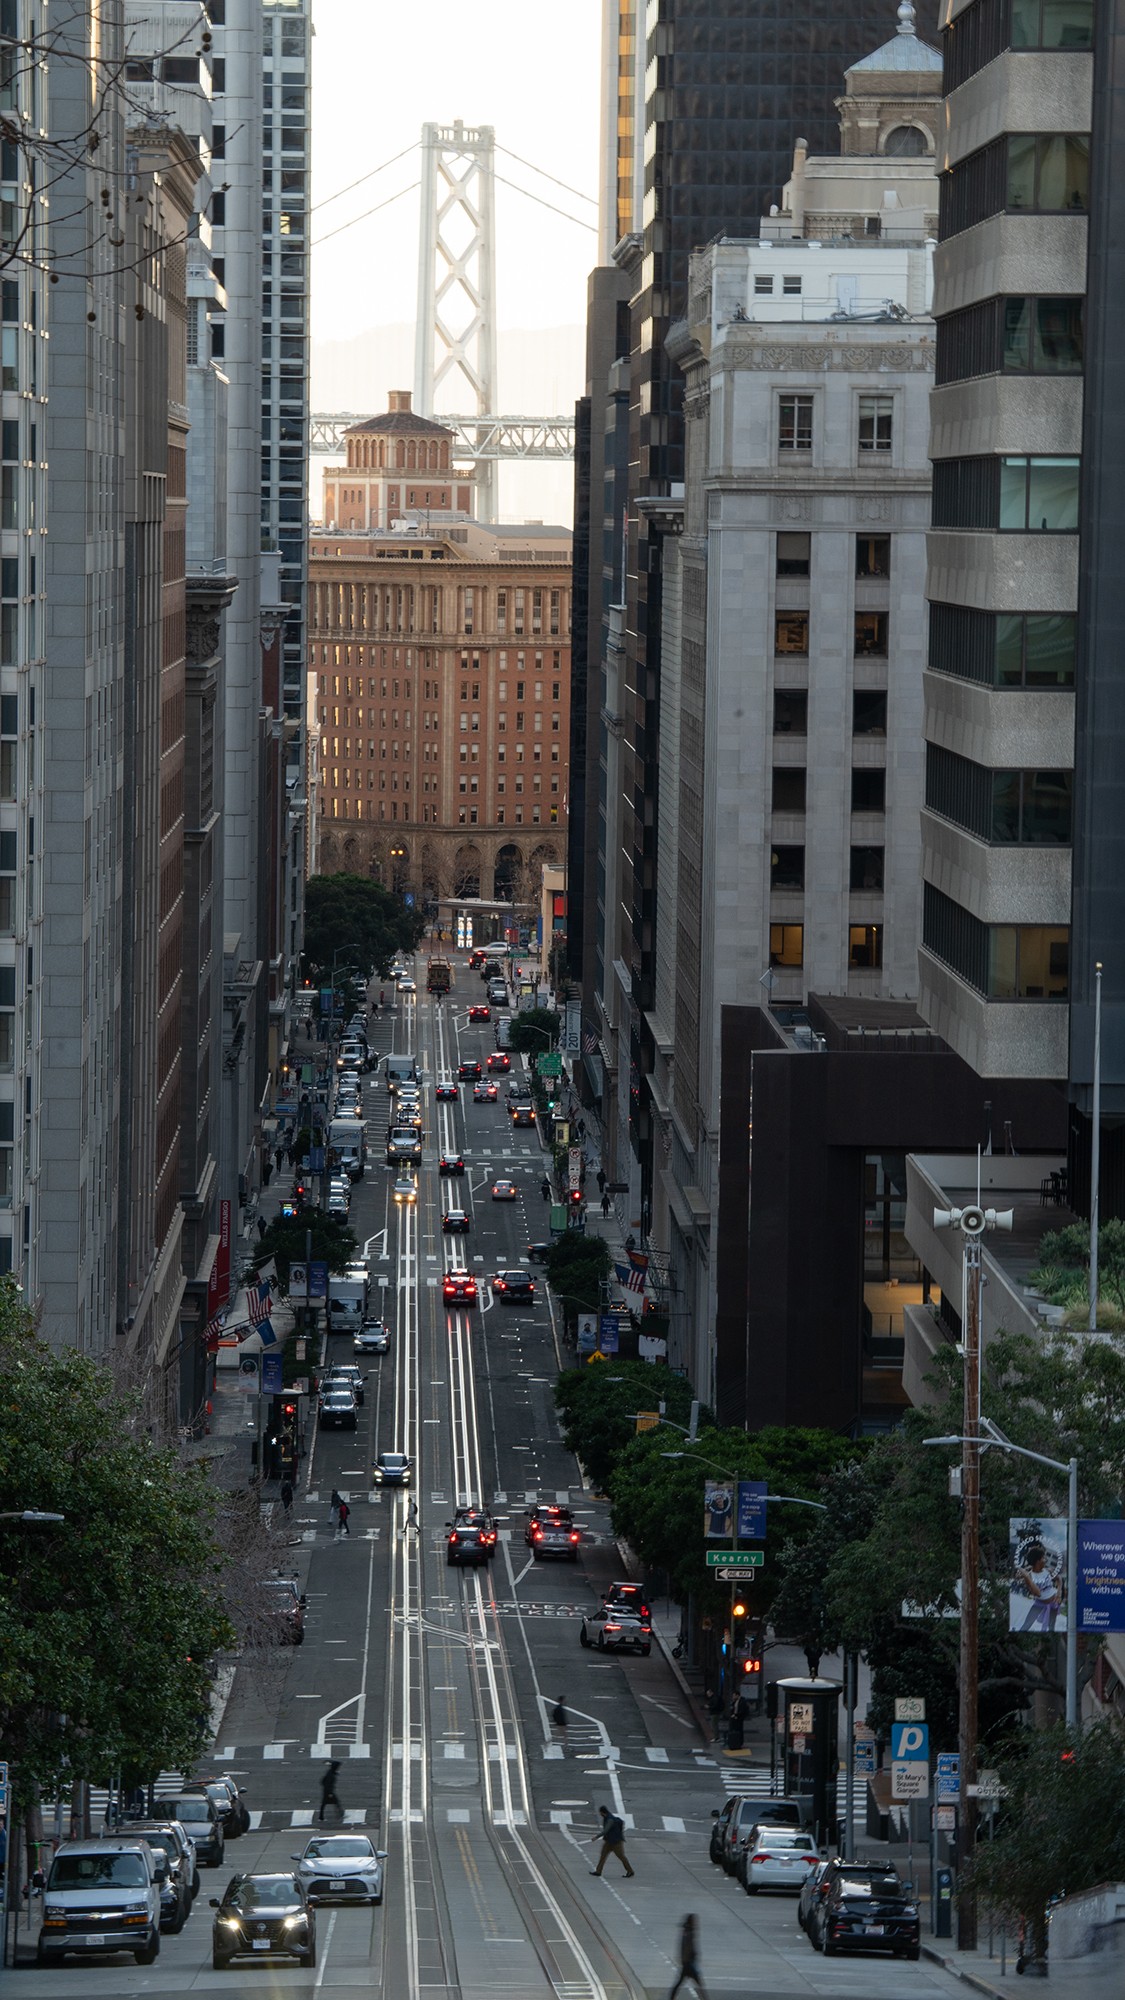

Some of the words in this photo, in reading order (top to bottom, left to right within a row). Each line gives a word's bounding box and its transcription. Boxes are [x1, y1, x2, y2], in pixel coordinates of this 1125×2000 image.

[568, 1033, 579, 1049] 201
[210, 1266, 218, 1291] WELLS
[1083, 1541, 1123, 1551] Wherever
[713, 1554, 757, 1564] Kearny
[1083, 1567, 1096, 1575] we
[1096, 1566, 1118, 1577] bring
[1091, 1585, 1111, 1594] with
[1111, 1586, 1123, 1595] us.
[519, 1603, 588, 1611] CLEAR
[904, 1774, 926, 1782] Mary's
